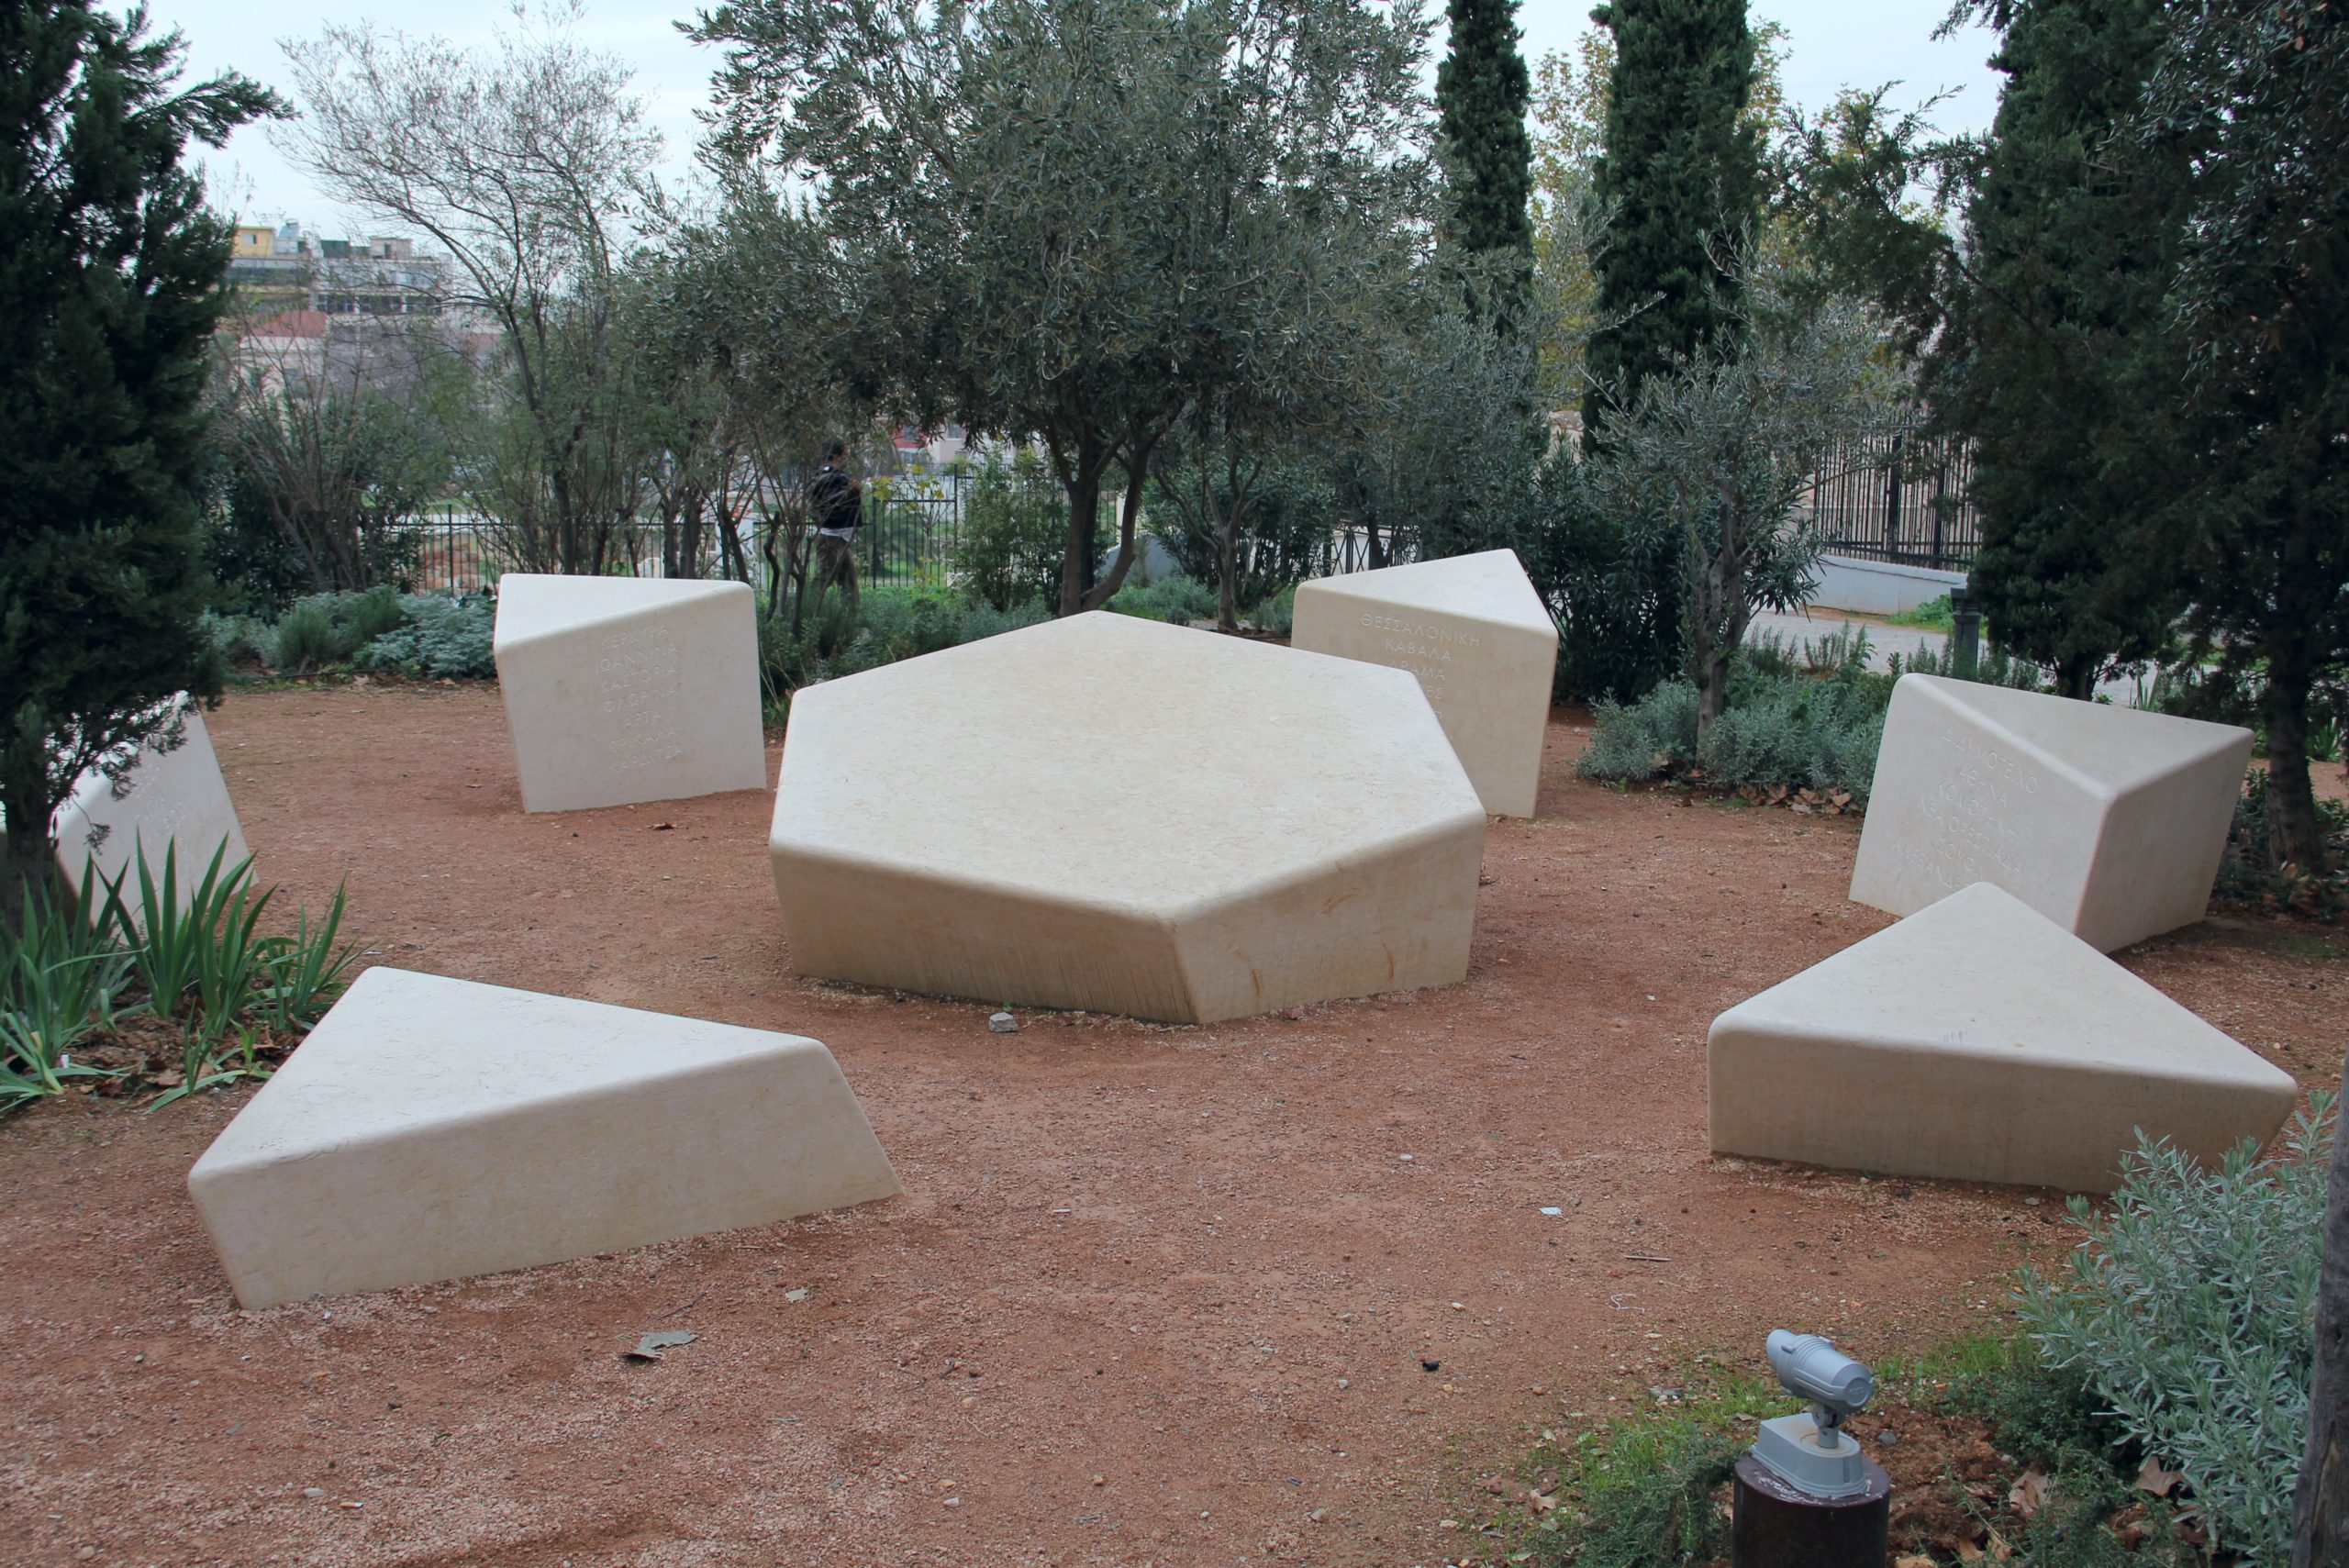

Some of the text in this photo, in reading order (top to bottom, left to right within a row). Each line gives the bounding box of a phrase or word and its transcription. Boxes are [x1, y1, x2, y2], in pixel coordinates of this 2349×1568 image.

[1360, 612, 1480, 647] ΘΕΣΣΑΛΟΝΙΚΗ
[1384, 638, 1452, 662] ΚΑΒΑΛΑ
[624, 709, 662, 728] ΑΡΤΑ
